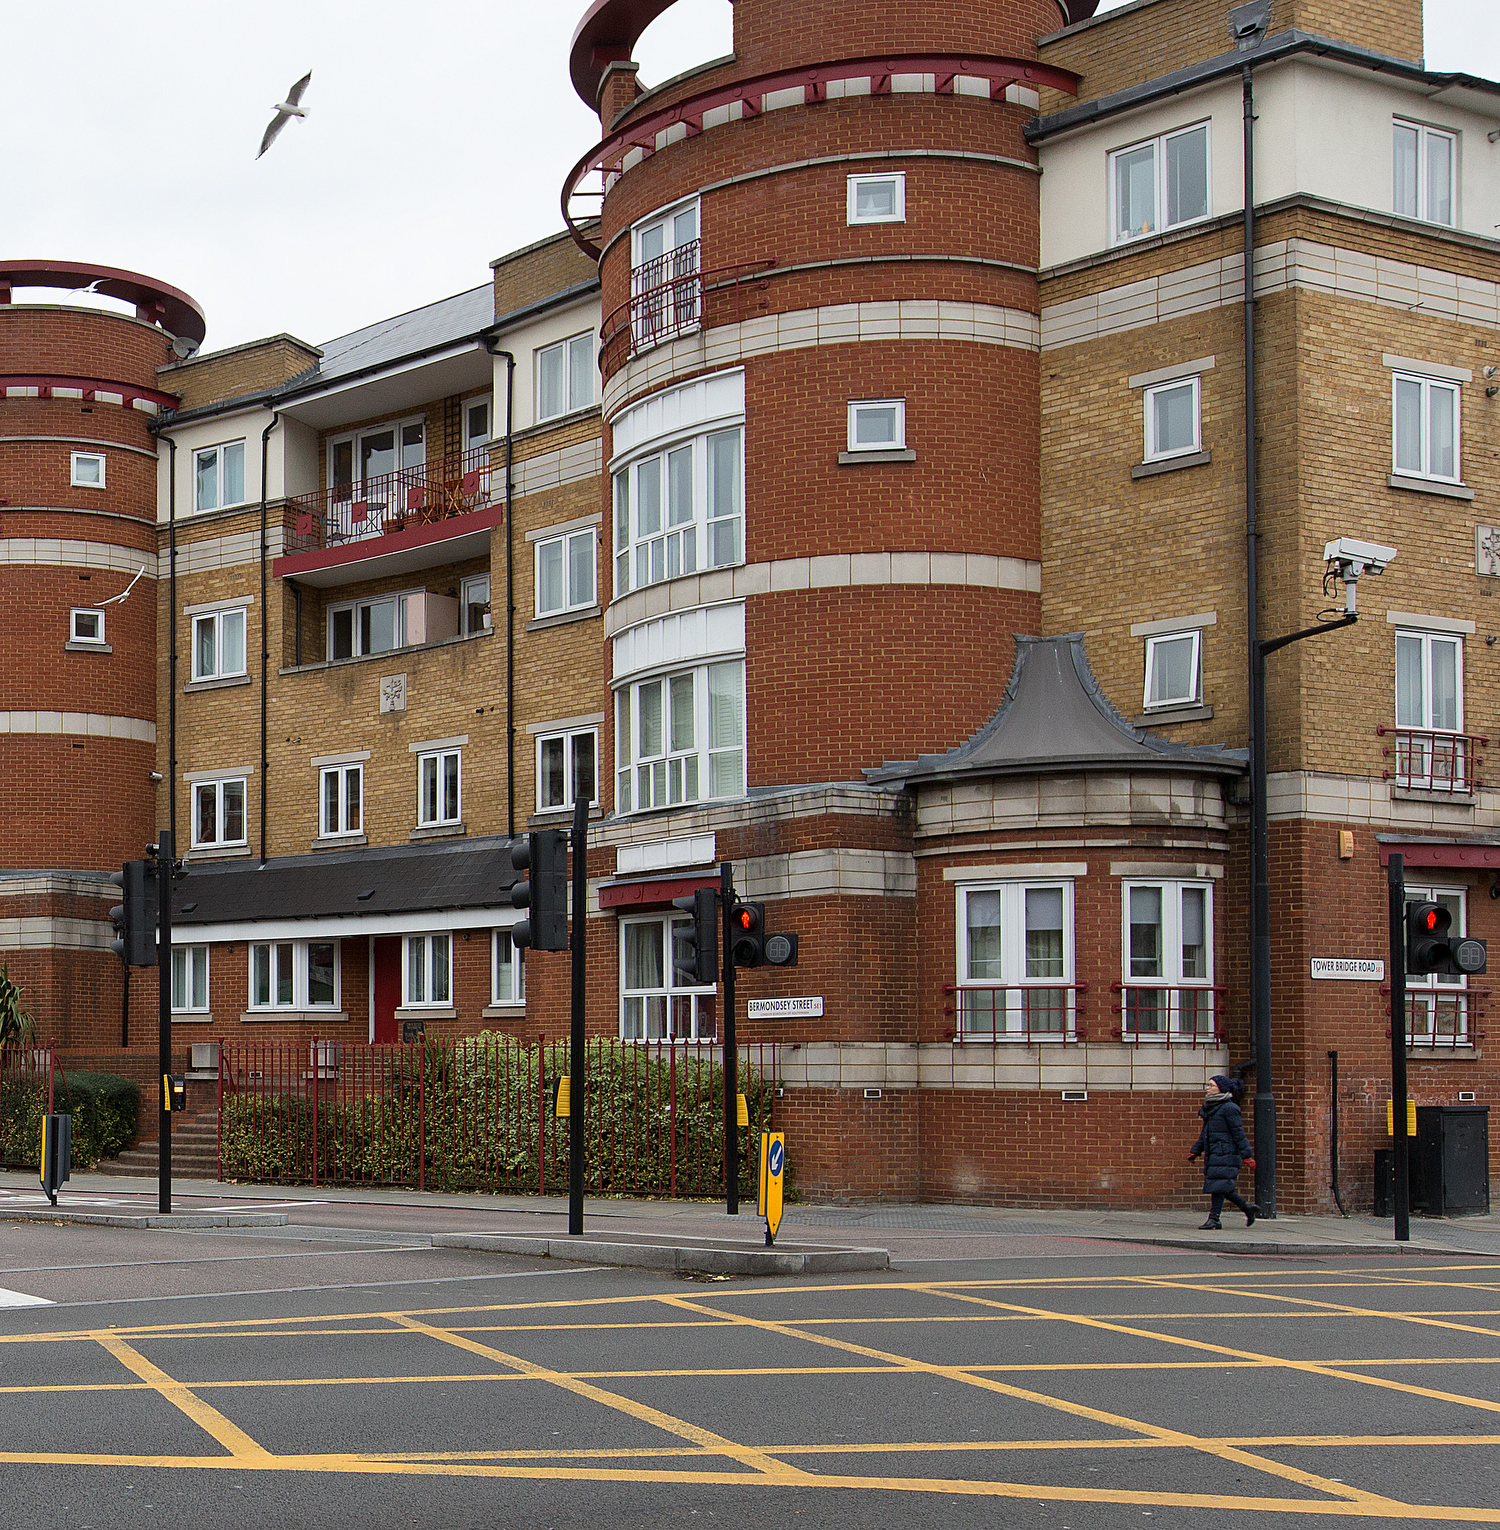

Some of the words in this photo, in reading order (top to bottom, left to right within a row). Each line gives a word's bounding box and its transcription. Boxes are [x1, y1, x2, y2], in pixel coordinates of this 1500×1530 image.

[1313, 960, 1335, 972] TOWER
[1336, 962, 1357, 972] BRIDGE
[1359, 962, 1376, 972] ROAD
[749, 1000, 791, 1012] BERMONDSEY
[792, 999, 813, 1010] STREET
